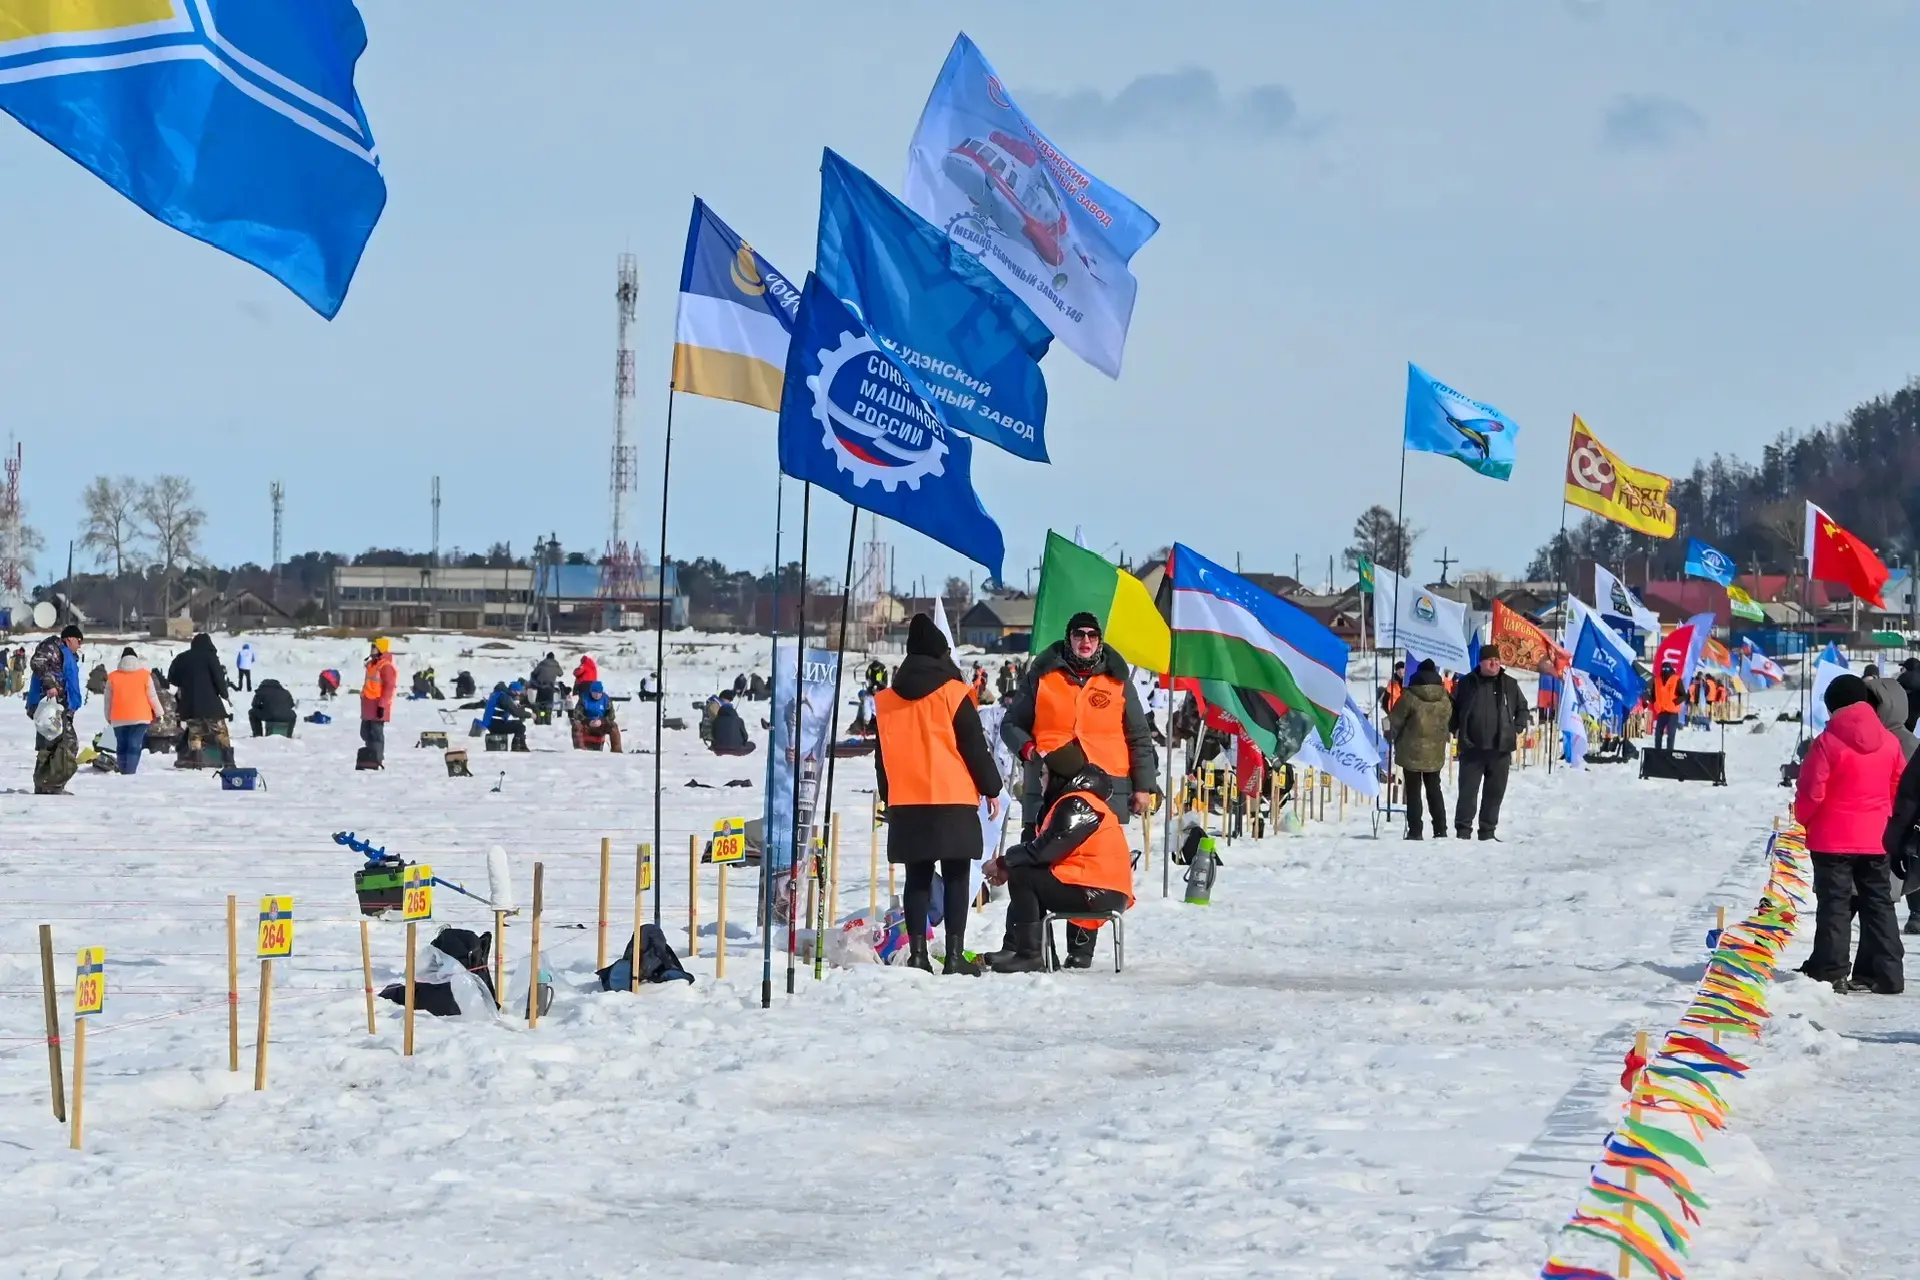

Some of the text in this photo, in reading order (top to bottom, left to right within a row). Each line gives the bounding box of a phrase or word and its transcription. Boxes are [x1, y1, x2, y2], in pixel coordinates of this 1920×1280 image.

[1076, 193, 1113, 229] ЗАВОД
[953, 224, 1084, 323] МЕХАНО-СБОРОЧНЫЙ ЗАВОД-146
[852, 401, 924, 447] РОССИИ
[978, 405, 1035, 442] ЗАВОД
[1617, 490, 1666, 524] ПРОМ
[716, 837, 738, 857] 268
[407, 890, 426, 914] 265
[262, 924, 285, 949] 264
[78, 979, 97, 1007] 263
